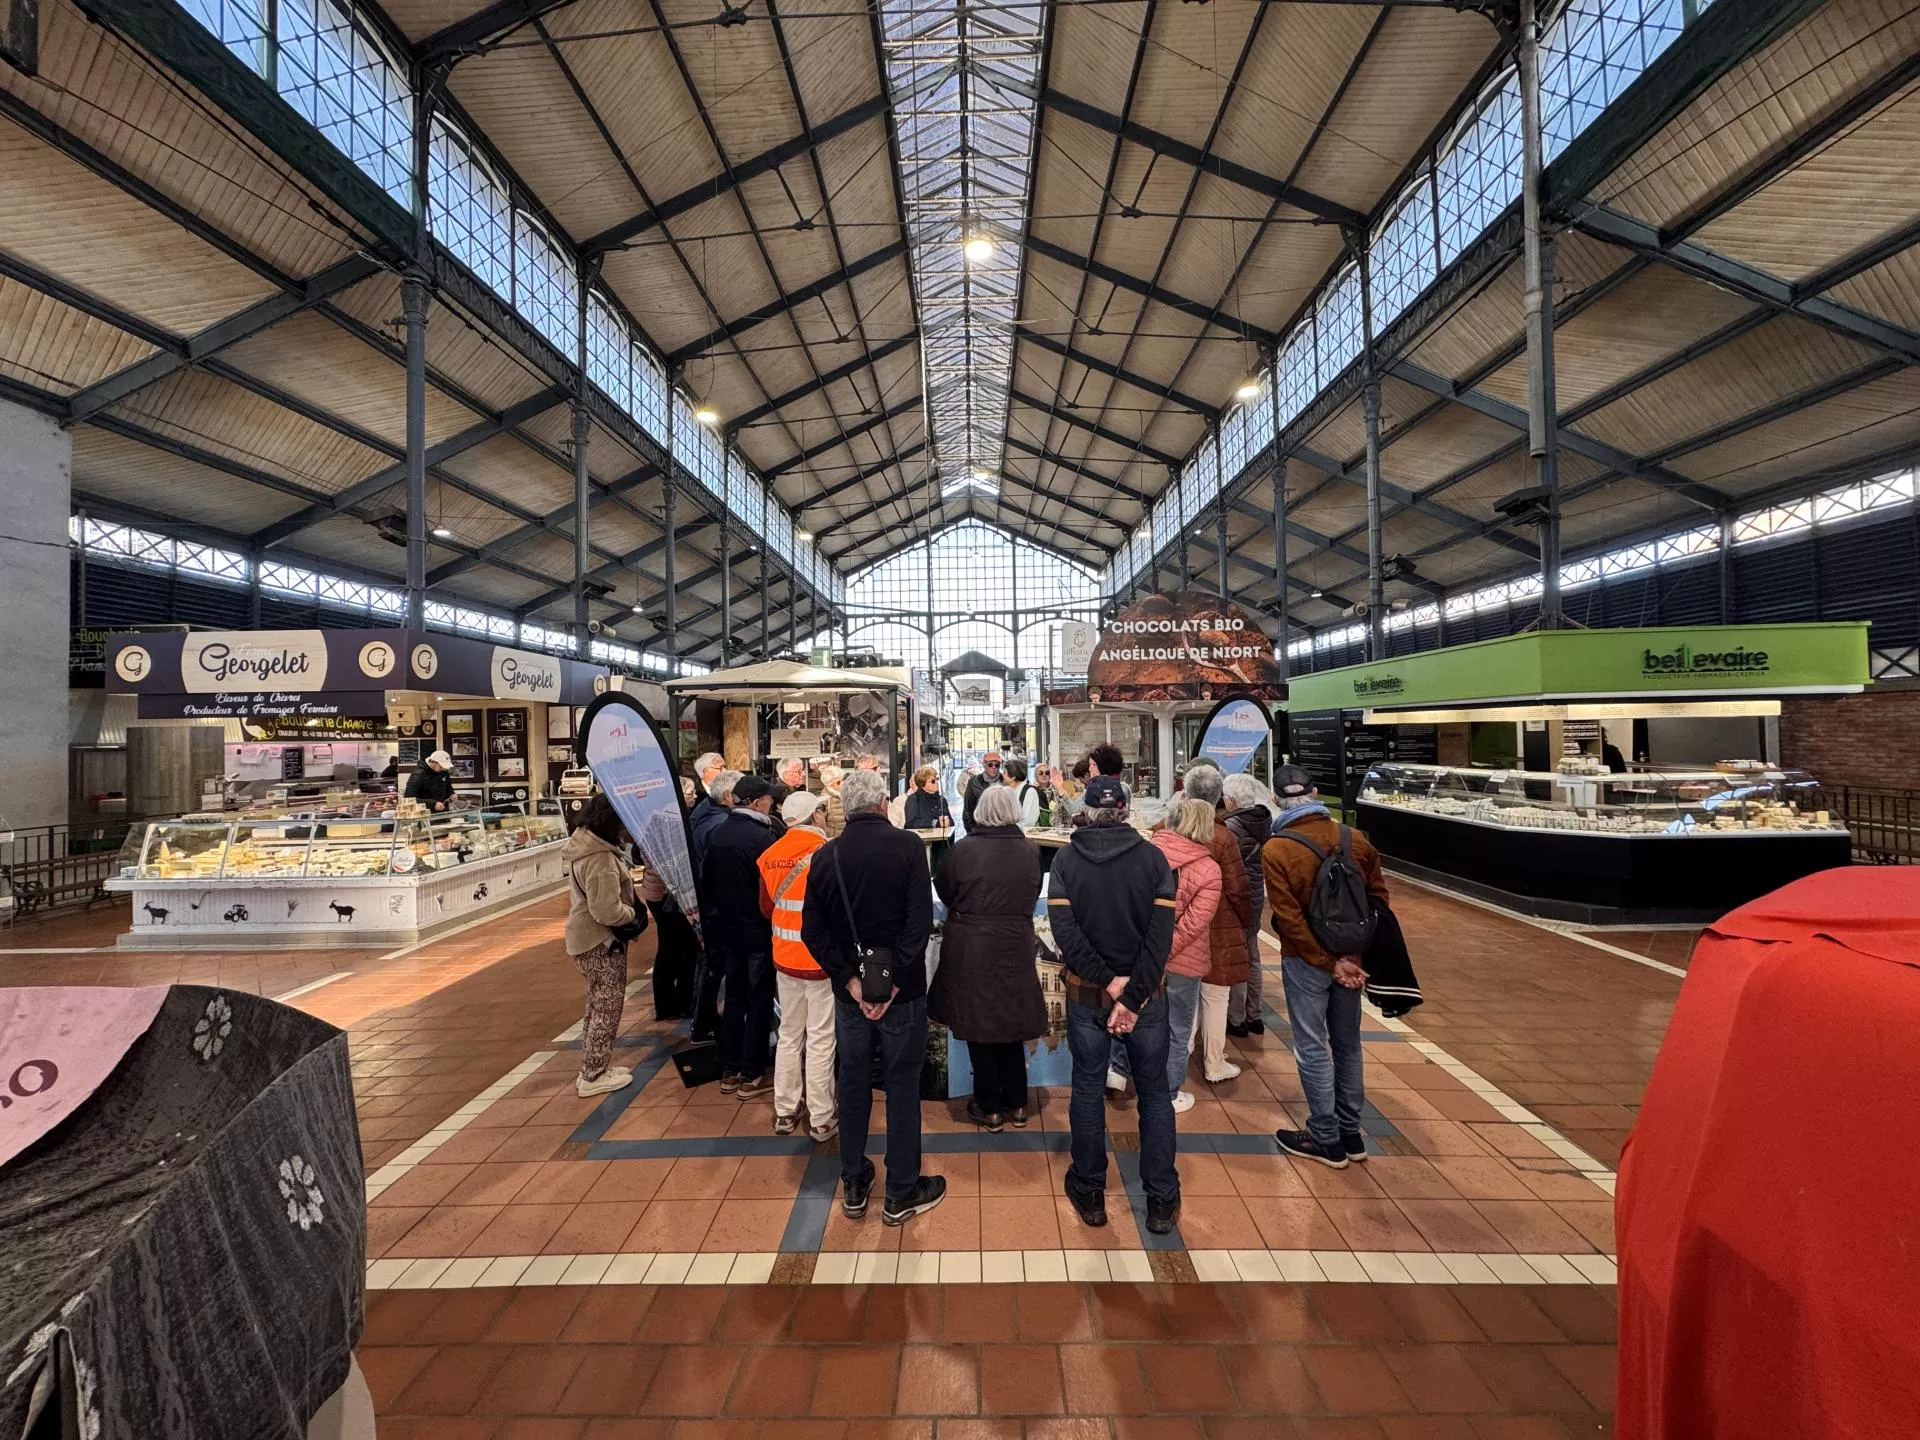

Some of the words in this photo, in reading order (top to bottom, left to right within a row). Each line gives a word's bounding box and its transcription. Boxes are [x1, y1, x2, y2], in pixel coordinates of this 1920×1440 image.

[1111, 619, 1209, 634] CHOCOLATS
[1214, 618, 1244, 632] BIO
[1098, 645, 1184, 661] ANGÉLIQUE
[1189, 647, 1209, 660] DE
[1213, 645, 1262, 659] NIORT
[199, 643, 310, 682] Georgelet
[501, 657, 555, 693] Georgelet
[183, 704, 233, 716] Producteur
[236, 705, 248, 715] de
[252, 703, 295, 718] Fromages
[299, 702, 339, 714] Fermiers
